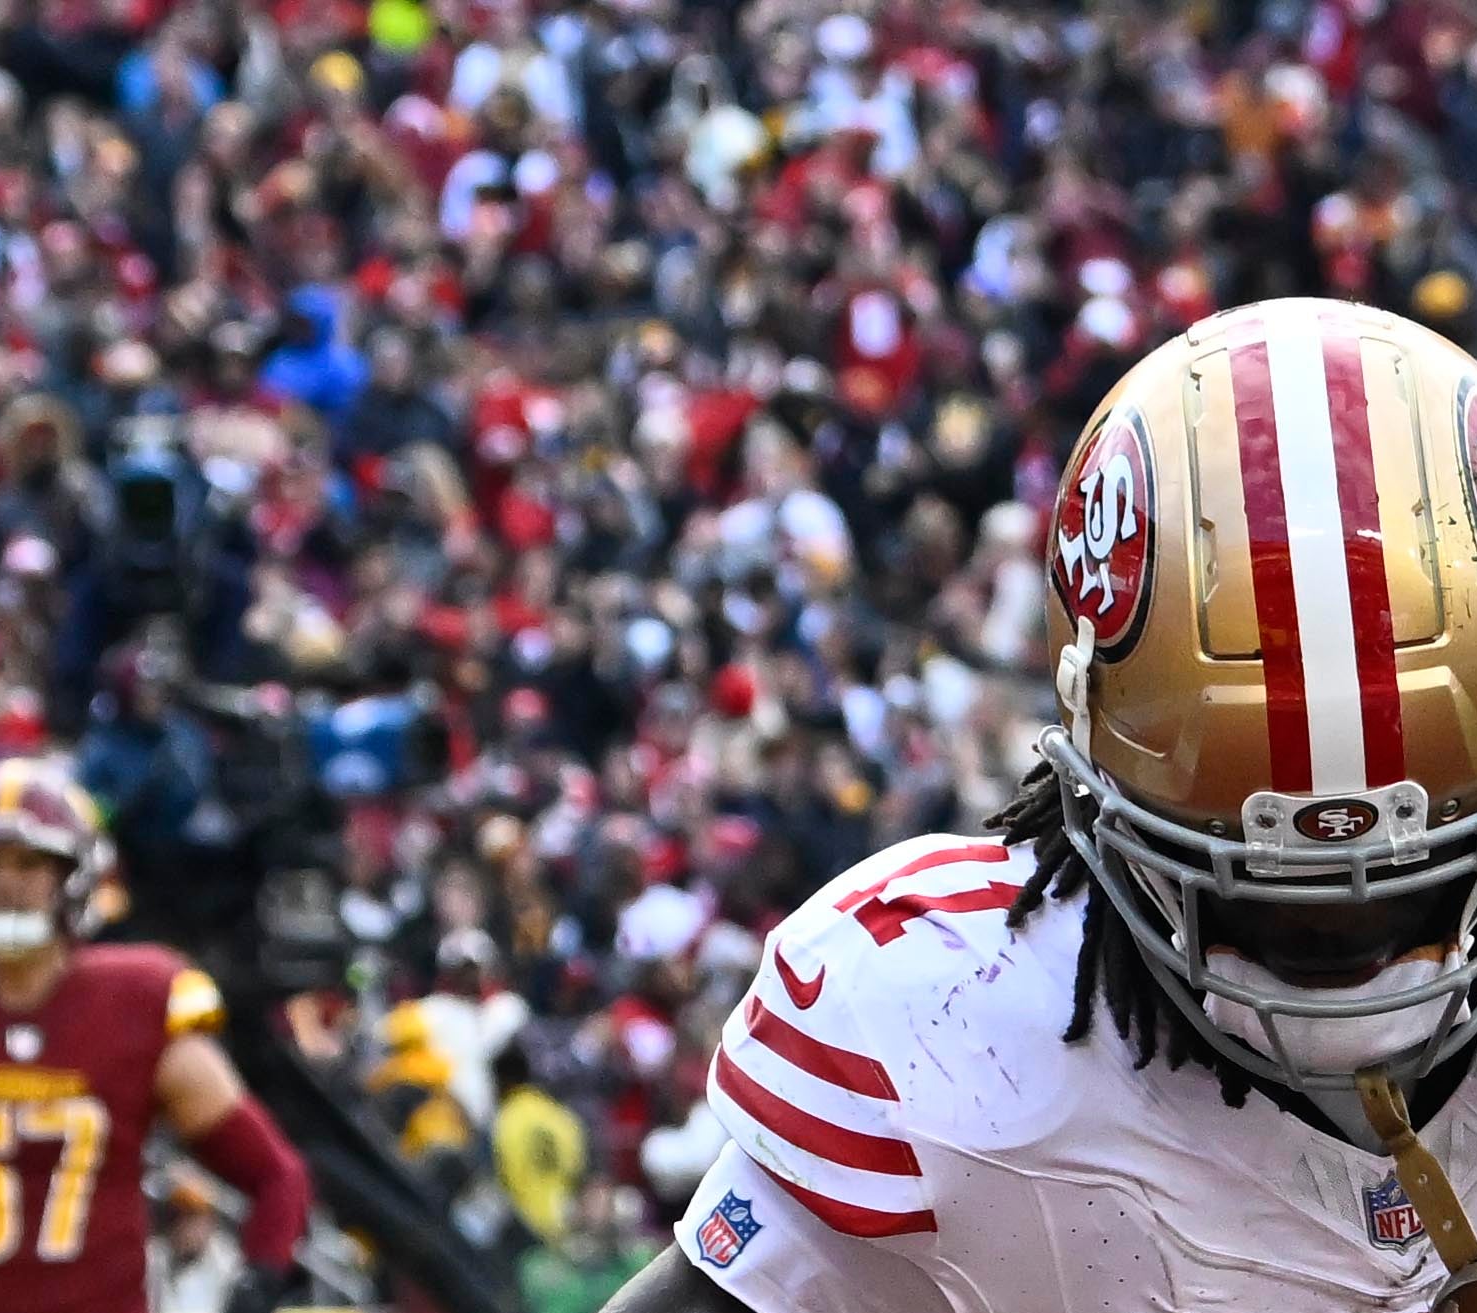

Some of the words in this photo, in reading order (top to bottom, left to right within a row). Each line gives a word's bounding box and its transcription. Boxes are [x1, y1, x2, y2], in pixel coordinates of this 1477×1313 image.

[1317, 808, 1364, 838] SF
[701, 1211, 738, 1264] NFL
[1375, 1206, 1422, 1240] NFL
